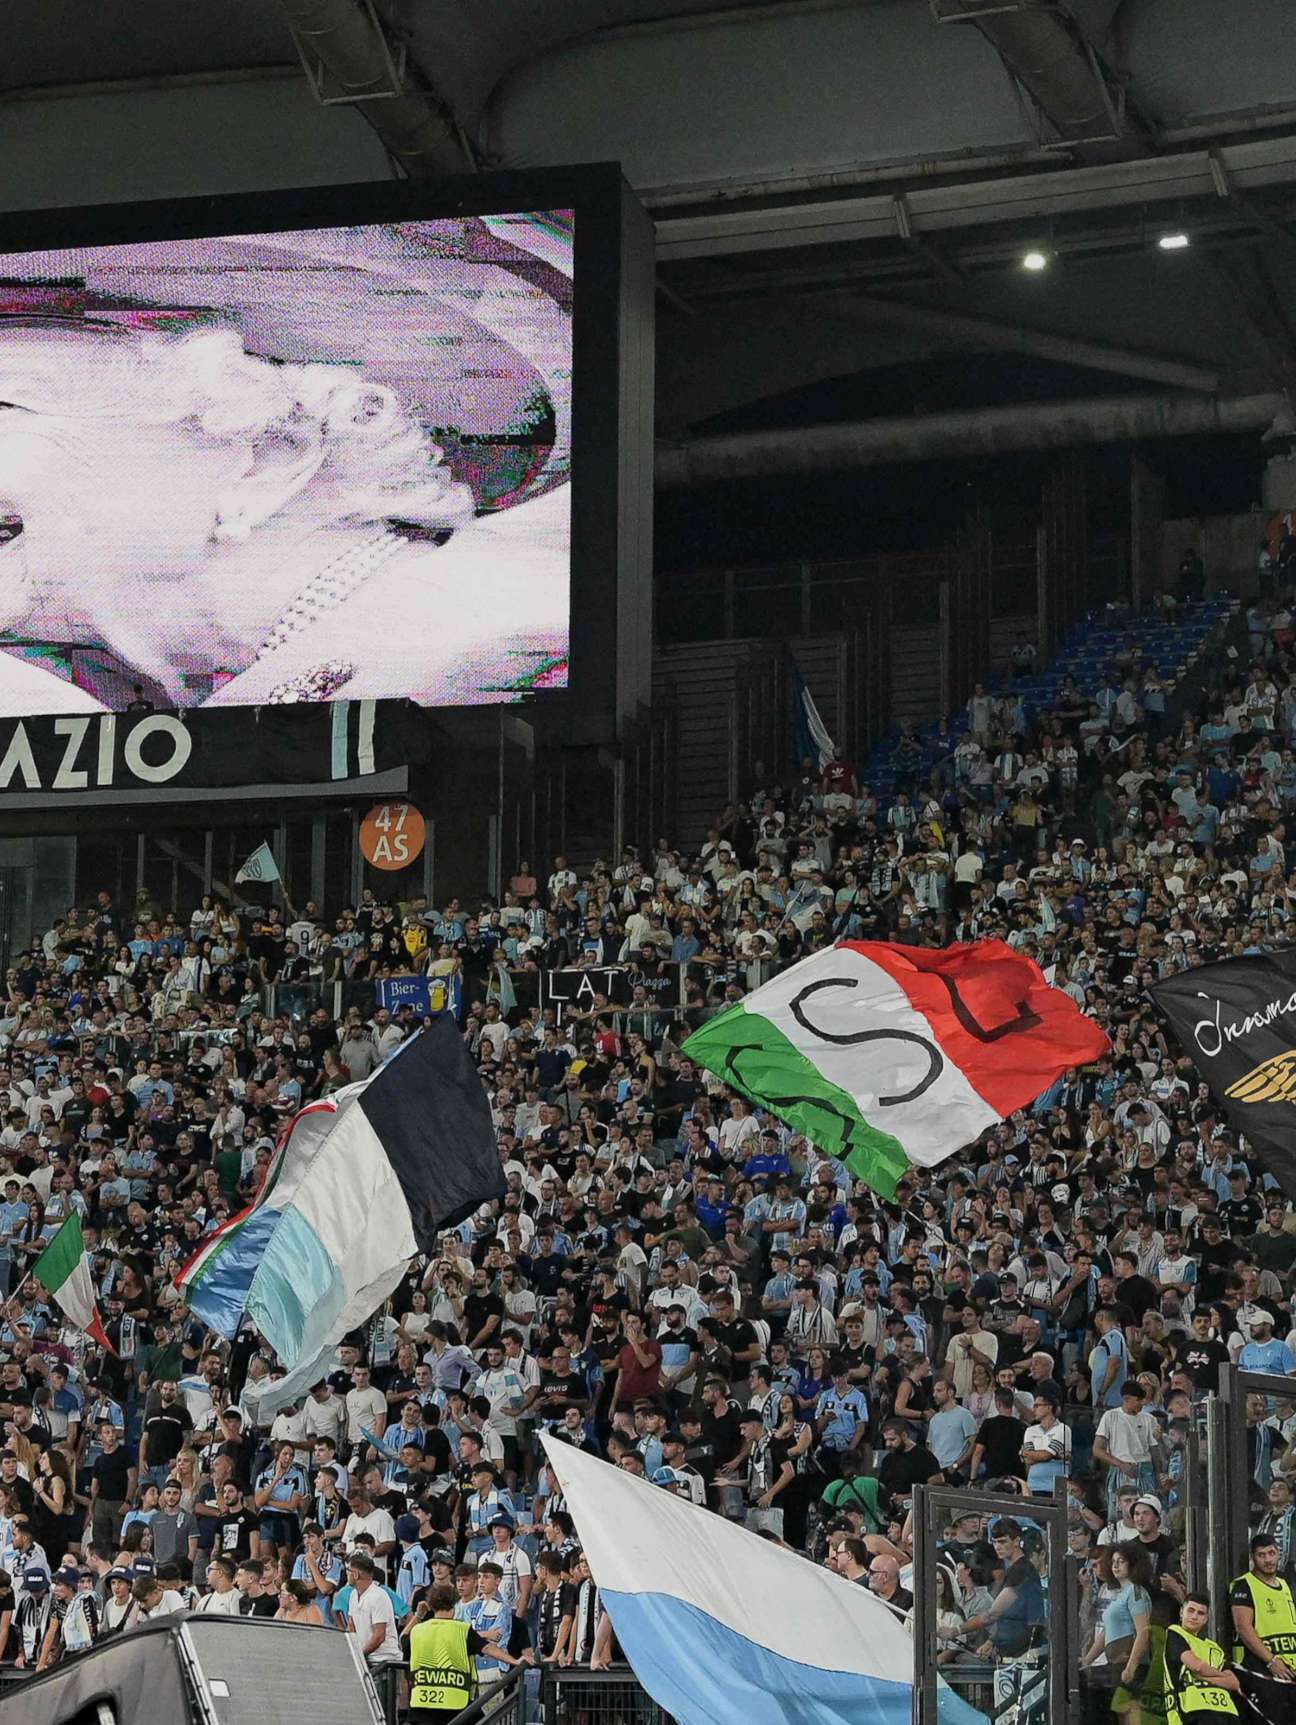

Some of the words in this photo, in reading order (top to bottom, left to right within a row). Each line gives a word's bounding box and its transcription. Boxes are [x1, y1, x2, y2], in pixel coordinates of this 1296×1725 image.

[375, 804, 409, 833] 47
[372, 833, 410, 863] AS
[391, 981, 421, 997] Bier-
[391, 1000, 423, 1015] Zne
[419, 1689, 445, 1704] 322
